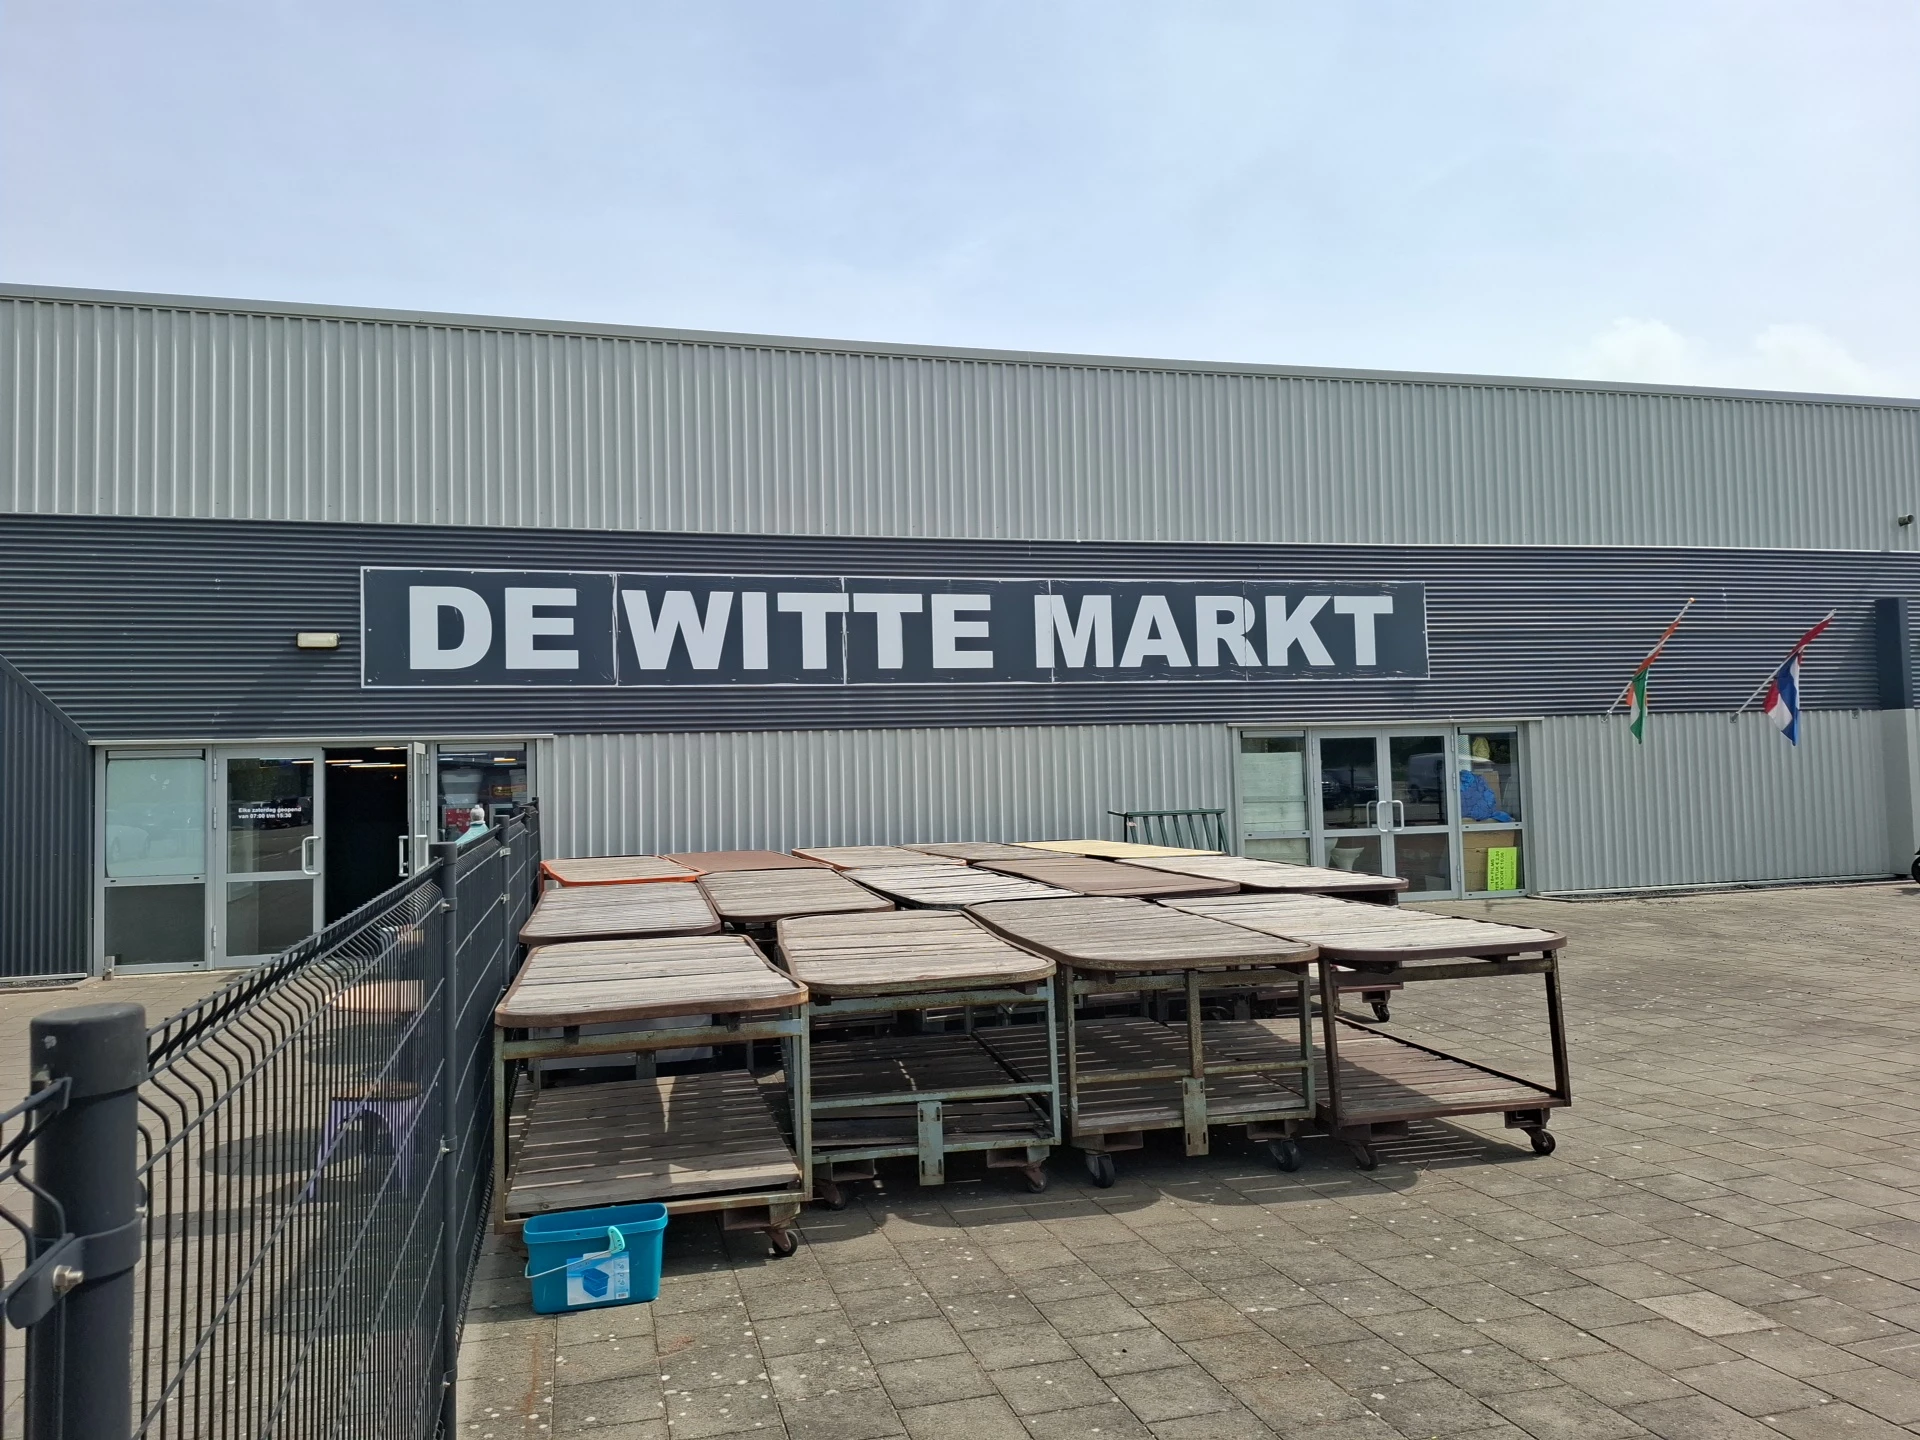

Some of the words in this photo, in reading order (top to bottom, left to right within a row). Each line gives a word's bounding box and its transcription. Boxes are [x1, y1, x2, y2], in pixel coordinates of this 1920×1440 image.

[409, 586, 579, 669] DE
[621, 590, 993, 669] WITTE
[1035, 594, 1394, 668] MARKT
